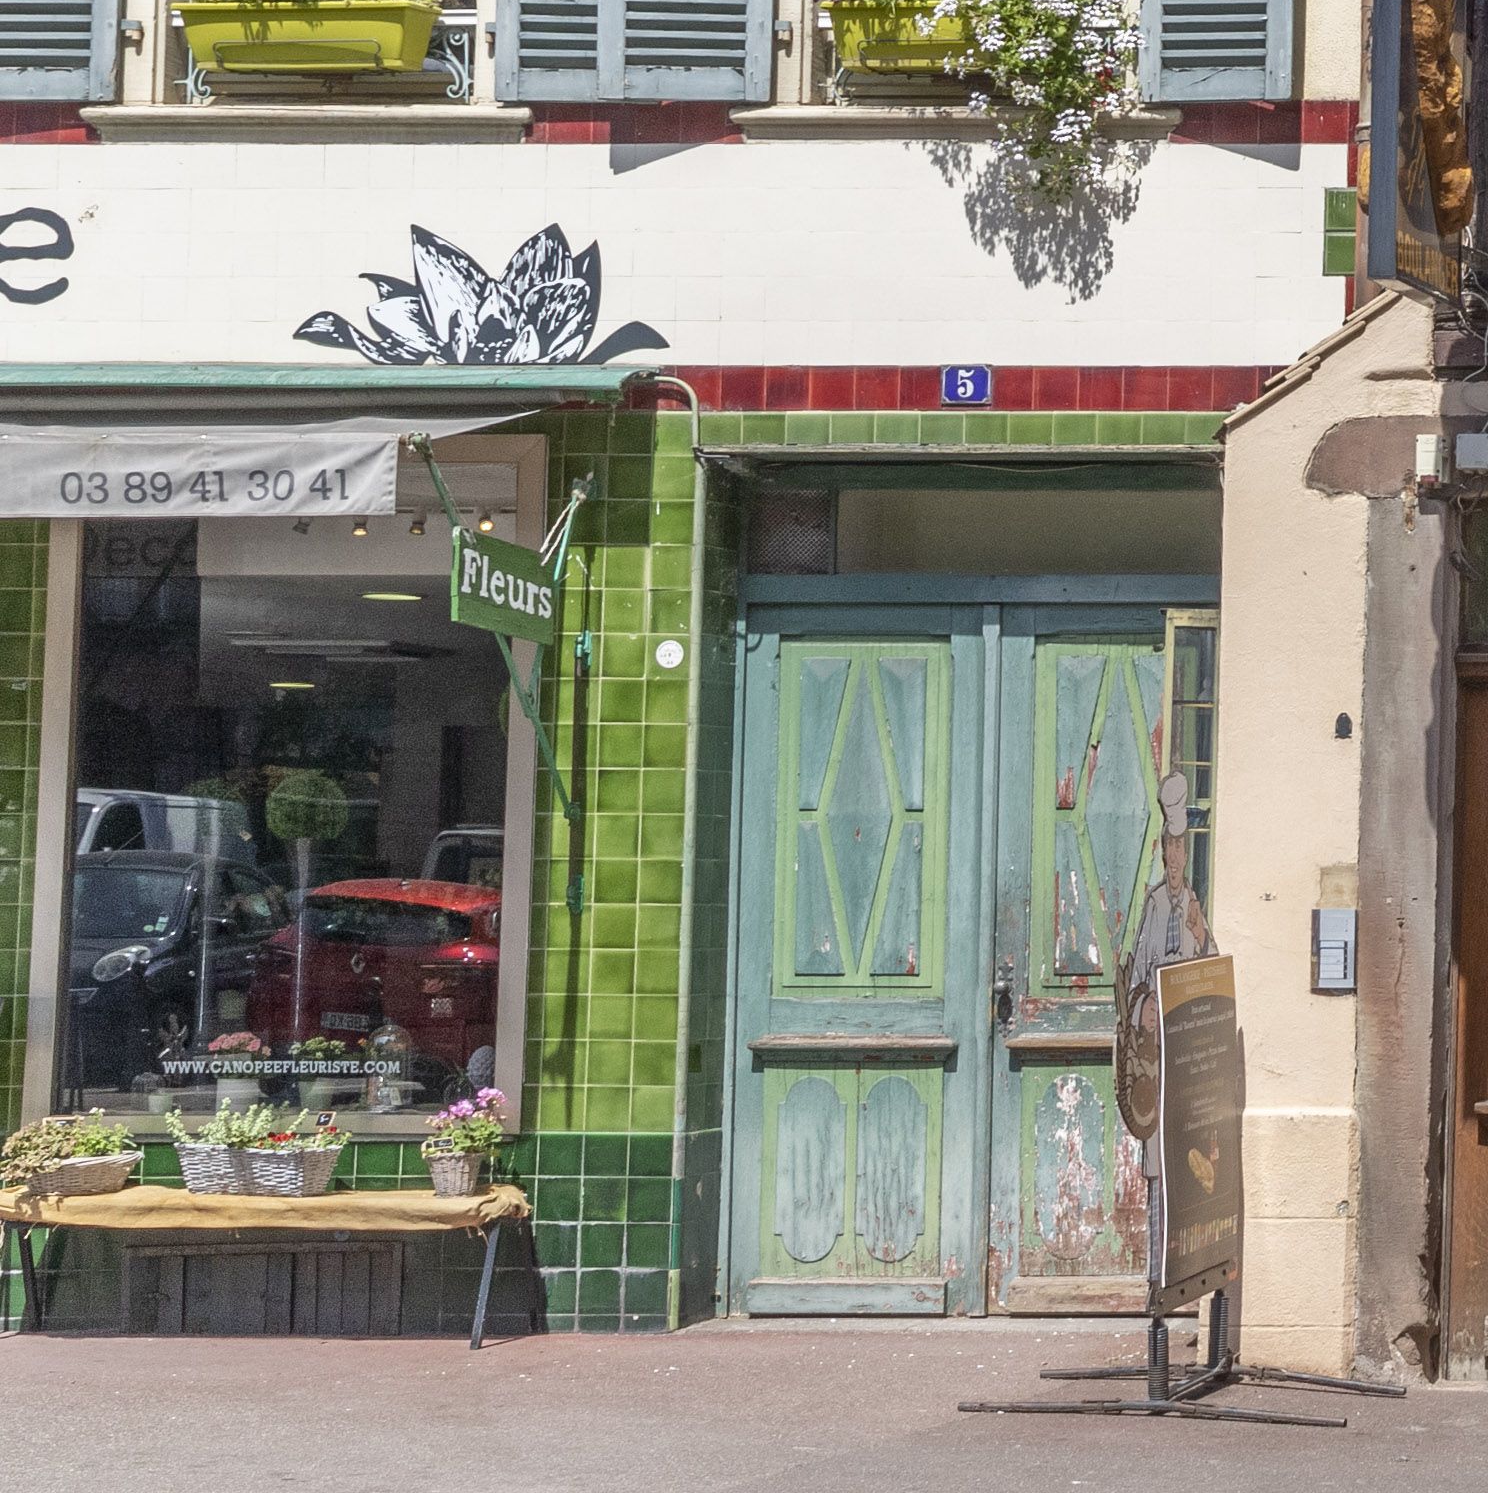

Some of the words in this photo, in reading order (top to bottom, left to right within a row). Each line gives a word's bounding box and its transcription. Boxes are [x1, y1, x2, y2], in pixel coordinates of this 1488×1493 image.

[956, 369, 974, 399] 5
[61, 472, 108, 504] 03
[124, 472, 172, 503] 89
[190, 470, 228, 502] 41
[248, 469, 294, 501] 30
[309, 469, 348, 500] 41
[461, 548, 552, 618] Fleurs
[163, 1060, 400, 1074] WWW.CANOPEEFLEURISTE.COM
